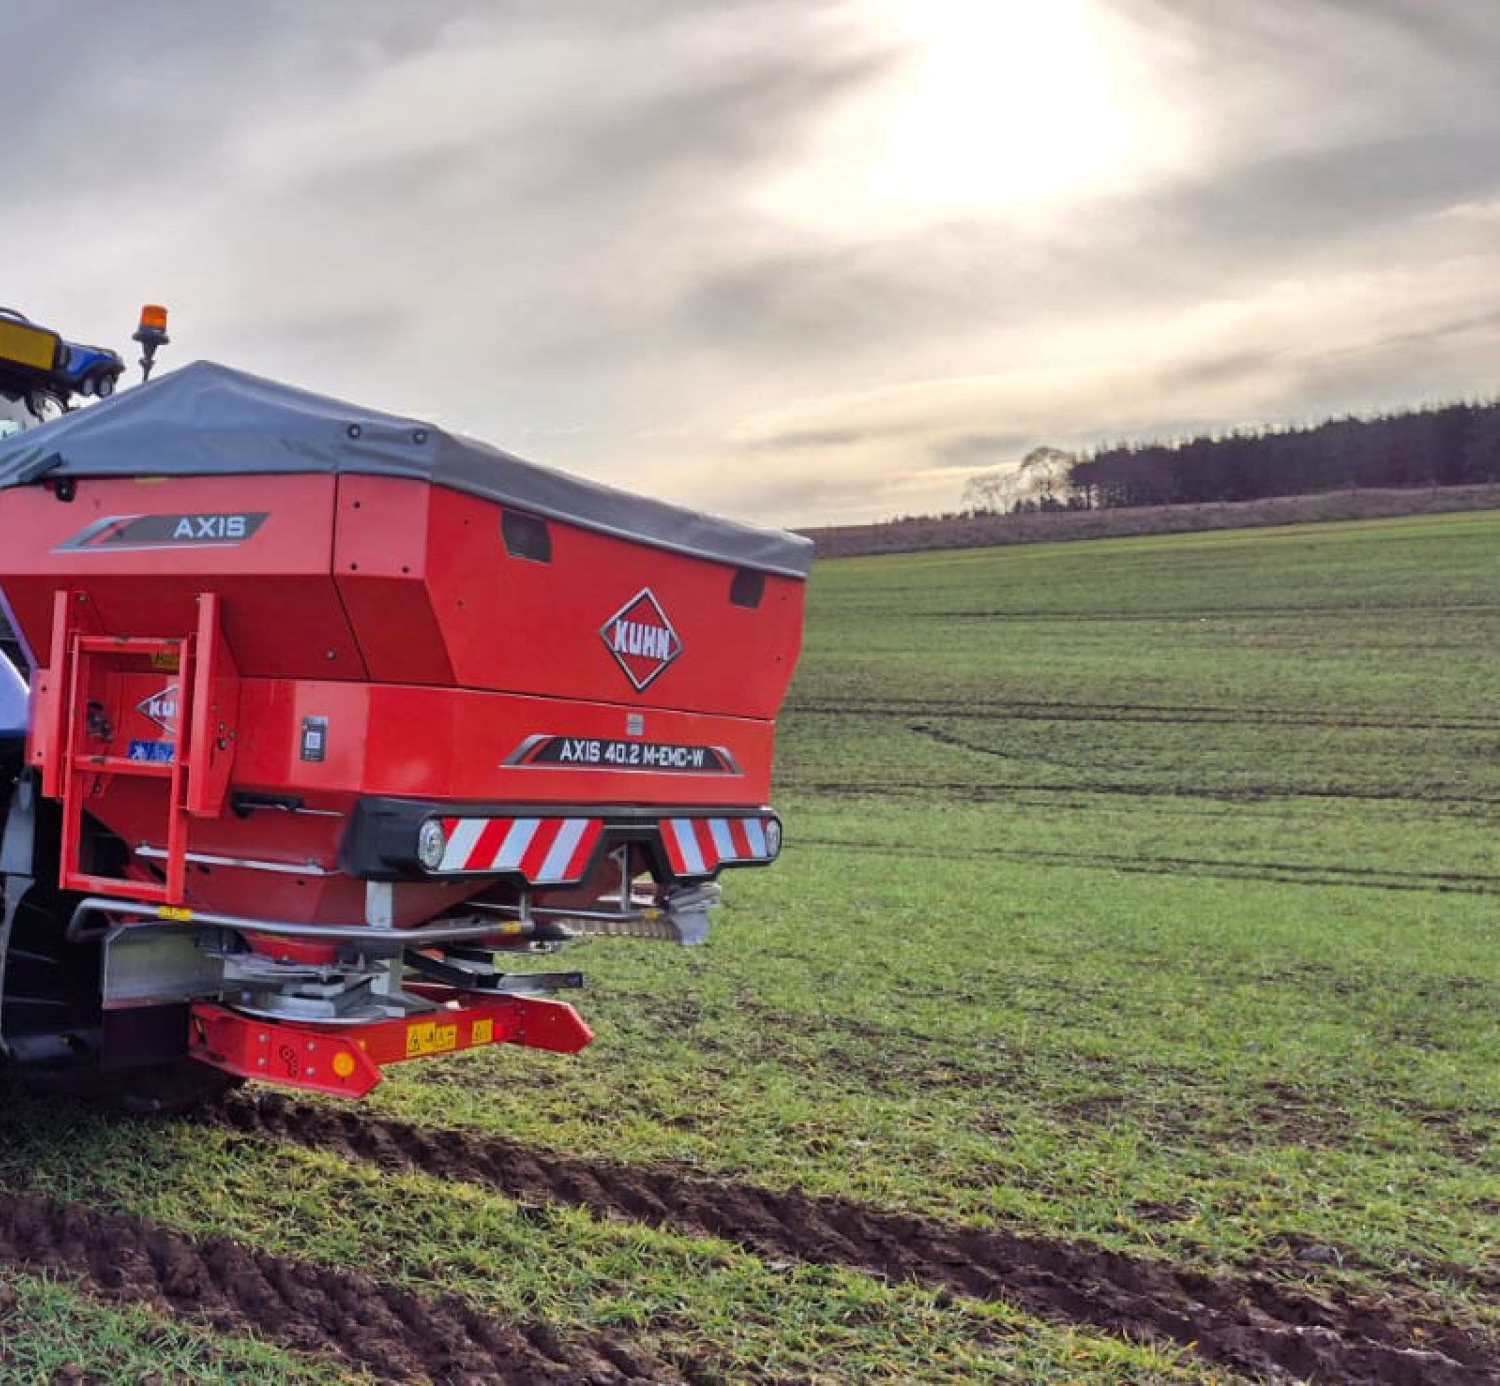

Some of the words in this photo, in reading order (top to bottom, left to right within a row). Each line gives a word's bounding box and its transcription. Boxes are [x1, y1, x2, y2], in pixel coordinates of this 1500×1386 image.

[173, 516, 246, 539] AXIS
[614, 619, 669, 661] KUHN
[149, 700, 177, 718] KU
[560, 739, 601, 762] AXIS
[605, 743, 640, 764] 40.2
[642, 745, 704, 767] M-EMC-W
